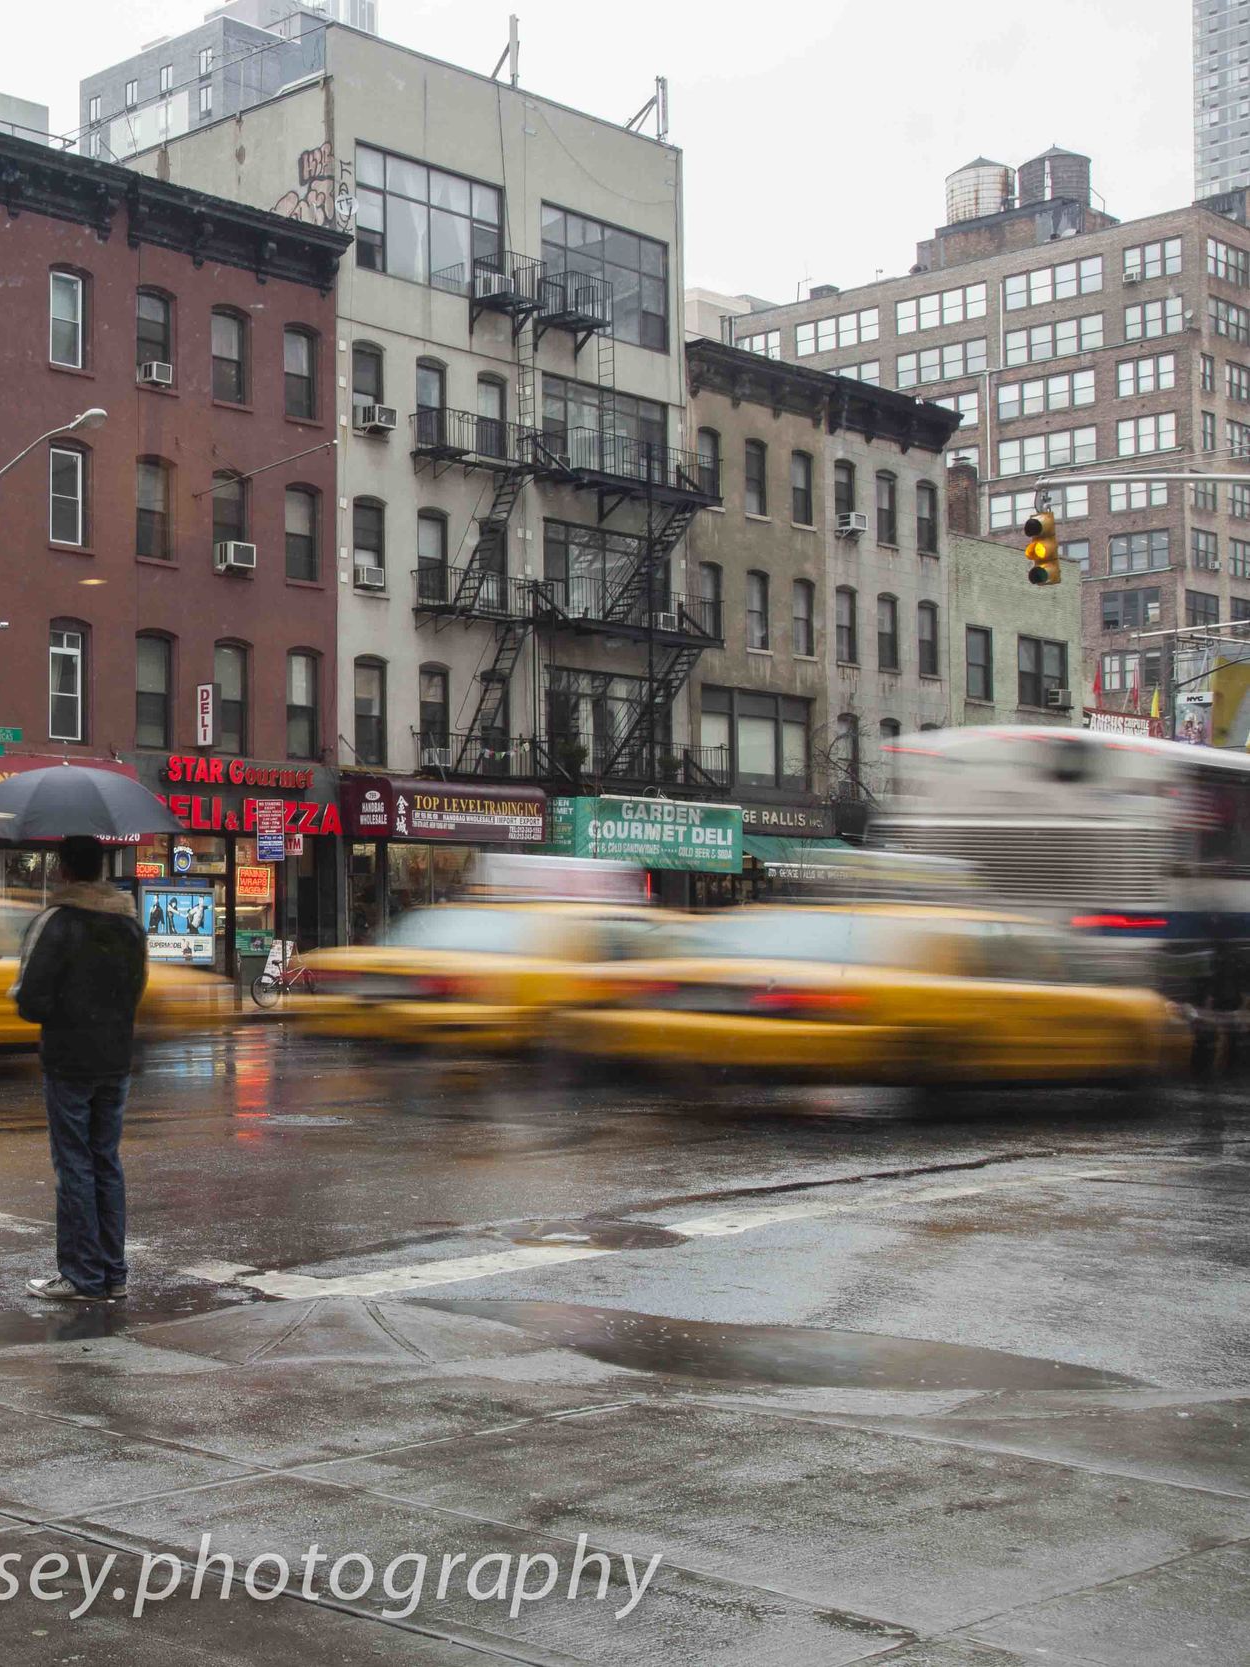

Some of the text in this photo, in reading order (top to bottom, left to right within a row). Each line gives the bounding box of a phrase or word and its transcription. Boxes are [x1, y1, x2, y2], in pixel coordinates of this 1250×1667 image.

[200, 689, 210, 742] DELI
[168, 755, 315, 789] STAR Gourmet
[155, 792, 343, 836] ELI & PZZA
[362, 802, 385, 813] HANDBAG
[414, 795, 439, 810] TOP
[444, 798, 483, 813] LEVEL
[483, 800, 524, 816] TRADING
[525, 803, 542, 817] INC.
[622, 803, 700, 825] GARDEN
[360, 814, 387, 825] WHOLESALE
[762, 811, 806, 827] RALLIS
[588, 820, 687, 842] GOURMET
[691, 827, 732, 846] DELI
[678, 846, 693, 857] COLD
[695, 847, 709, 858] BEER
[239, 886, 267, 894] BAGELS
[240, 878, 267, 886] WRAPS
